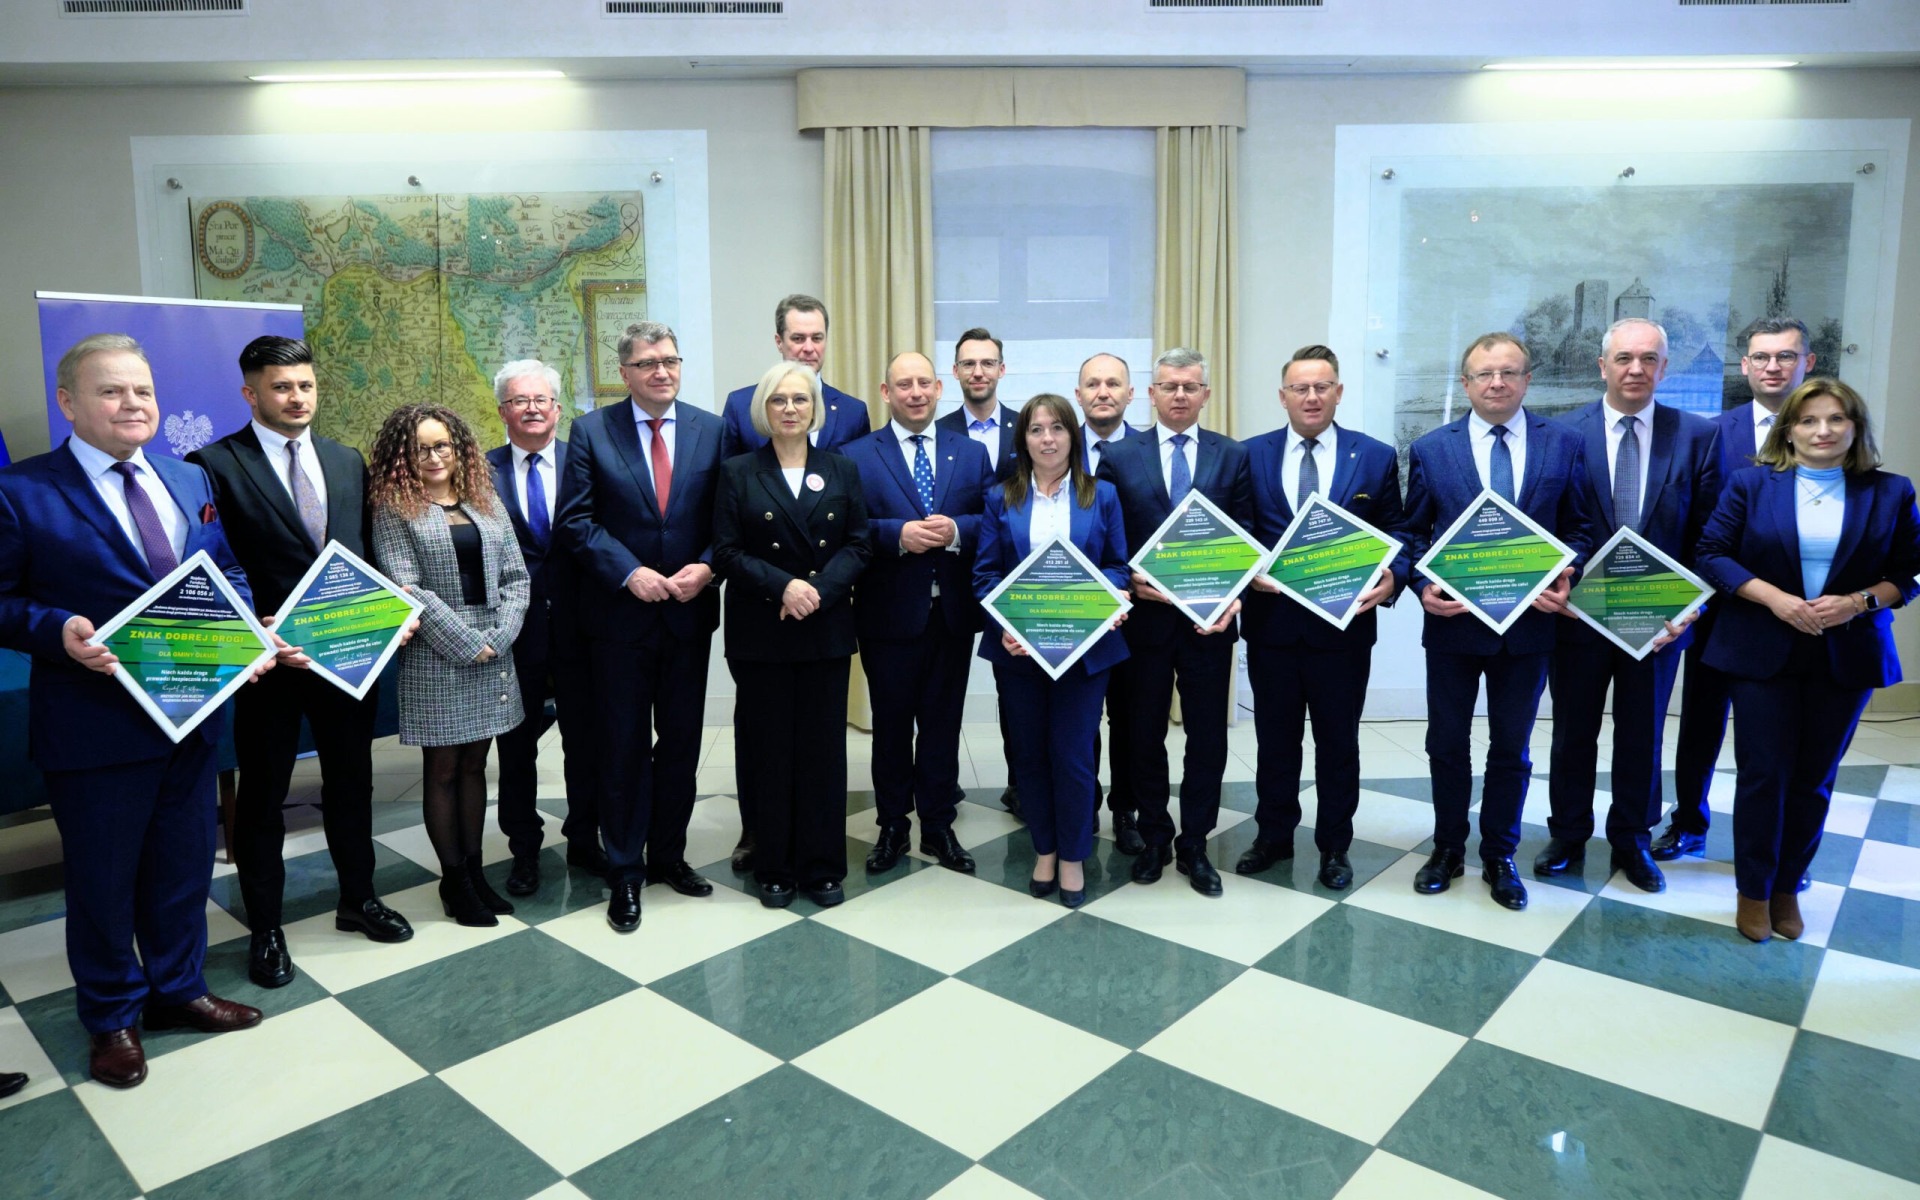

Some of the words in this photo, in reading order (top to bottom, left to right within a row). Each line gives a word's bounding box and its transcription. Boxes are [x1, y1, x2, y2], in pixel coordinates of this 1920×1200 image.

[1283, 556, 1305, 566] ZNAK
[1308, 549, 1340, 560] DOBREJ
[1344, 543, 1369, 552] DROGI
[294, 615, 321, 626] ZNAK
[324, 609, 360, 620] DOBREJ
[364, 603, 391, 613] DROGI
[130, 631, 161, 639] ZNAK
[166, 632, 208, 641] DOBREJ
